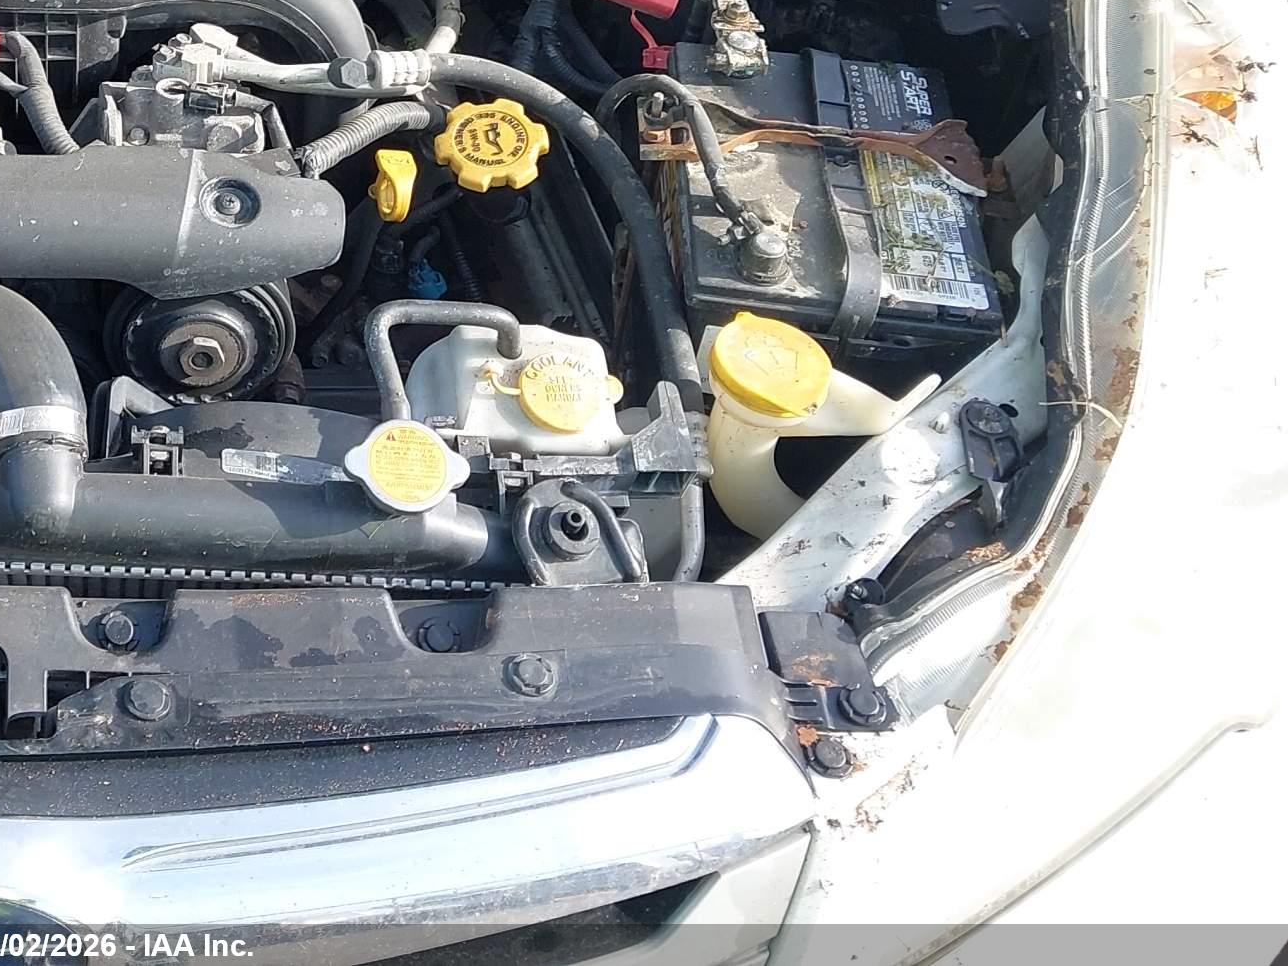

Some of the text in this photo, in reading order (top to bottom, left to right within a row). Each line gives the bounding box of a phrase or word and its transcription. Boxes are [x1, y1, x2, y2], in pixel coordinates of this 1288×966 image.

[900, 70, 922, 115] START
[915, 76, 933, 116] SUPER
[500, 114, 526, 143] ENGINE
